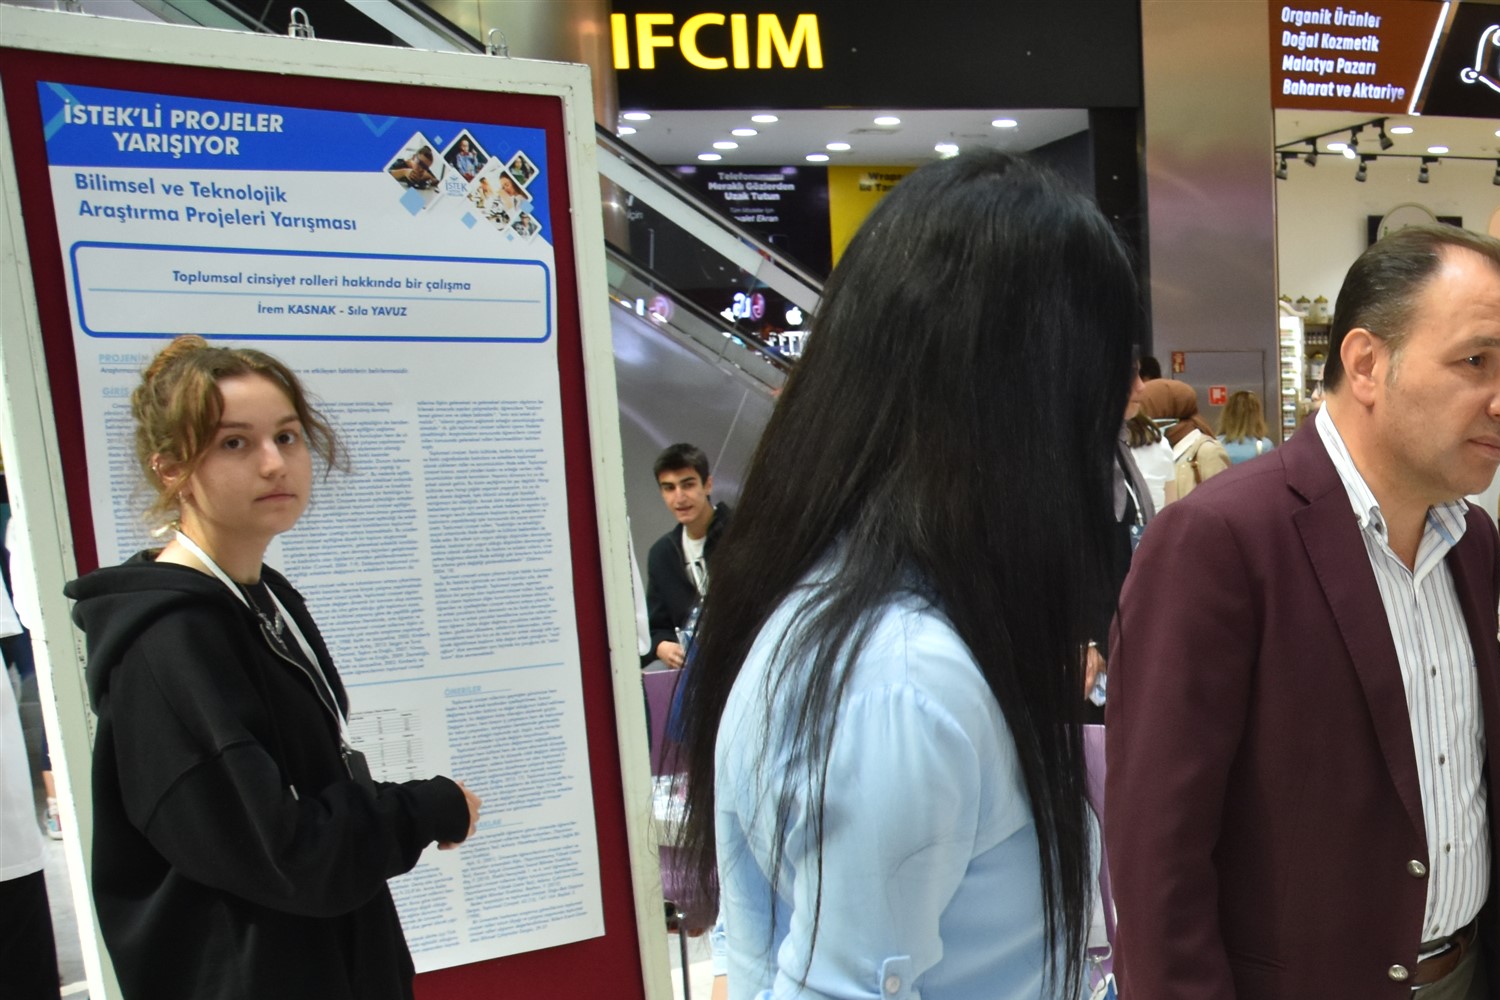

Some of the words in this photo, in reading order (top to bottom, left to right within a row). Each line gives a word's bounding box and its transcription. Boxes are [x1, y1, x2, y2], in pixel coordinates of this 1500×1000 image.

[1281, 6, 1332, 27] Organik
[1334, 6, 1381, 28] Ürünler
[610, 12, 824, 70] IFCIM
[1282, 30, 1319, 51] Doğal
[1321, 33, 1379, 52] Kozmetik
[1282, 54, 1335, 76] Malatya
[1336, 57, 1376, 75] Pazarı
[1283, 78, 1335, 97] Baharat
[1336, 84, 1351, 98] ve
[1352, 82, 1405, 103] Aktariye
[64, 98, 162, 128] İSTEK'Lİ
[170, 109, 284, 133] PROJELER
[113, 132, 240, 159] YARIŞIYOR
[74, 173, 156, 195] Bilimsel
[161, 183, 184, 197] ve
[190, 181, 288, 206] Teknolojik
[79, 200, 180, 223] Araştırma
[185, 206, 266, 228] Projeleri
[270, 210, 357, 233] Yarışması
[172, 270, 242, 285] Toplumsal
[246, 273, 296, 288] cinsiyet
[300, 274, 338, 287] rolleri
[342, 275, 401, 289] hakkında
[405, 277, 423, 289] bir
[426, 278, 471, 293] çalışma
[257, 300, 284, 314] İrem
[287, 304, 336, 315] KASNAK
[348, 305, 368, 316] Sıla
[371, 306, 408, 317] YAVUZ
